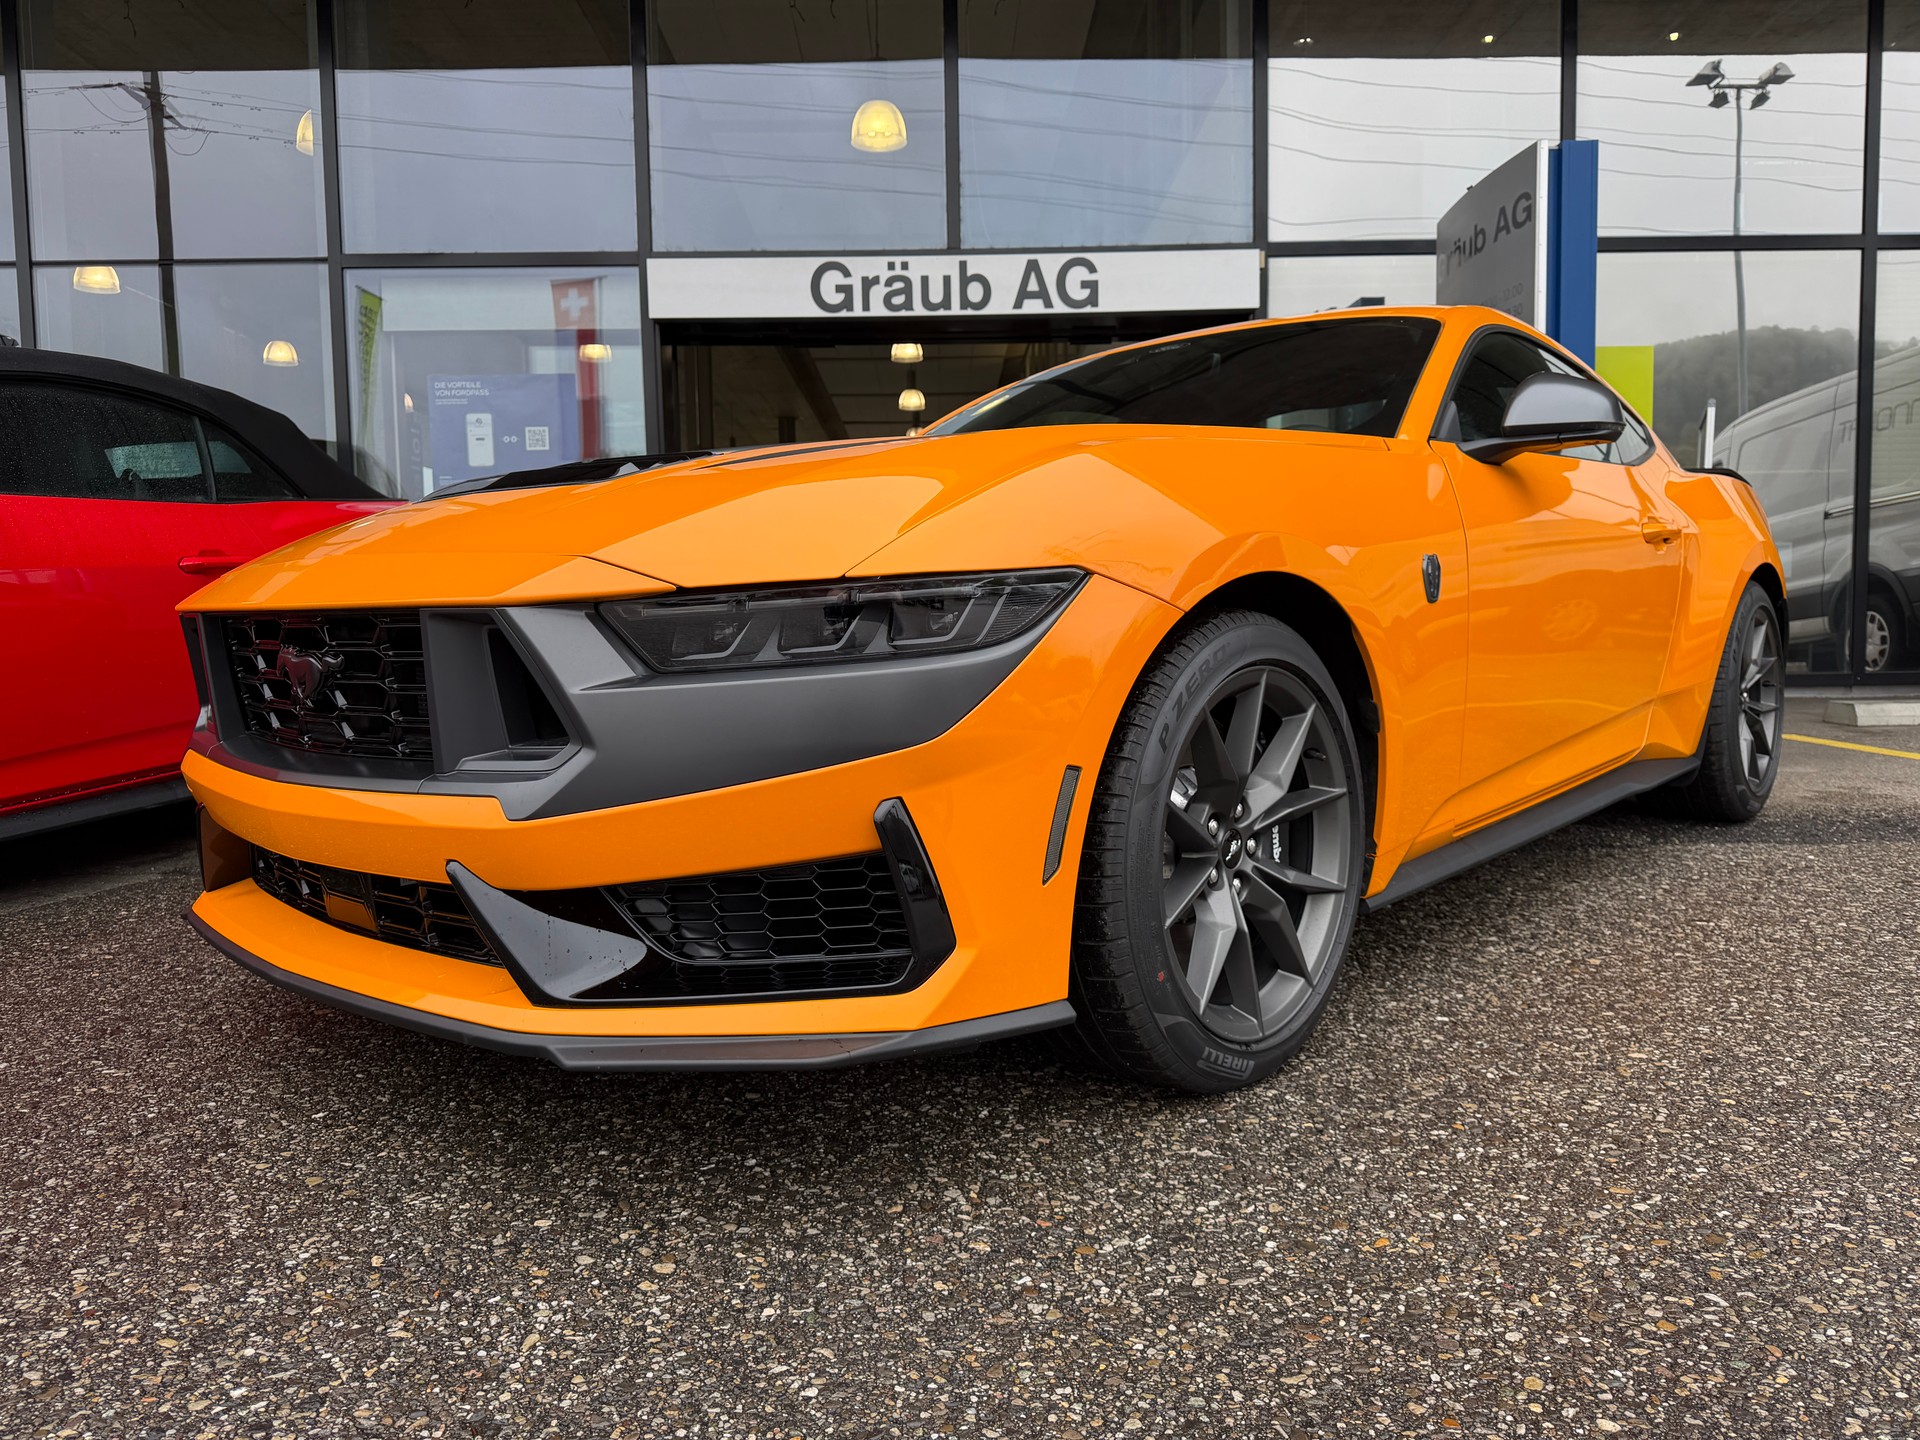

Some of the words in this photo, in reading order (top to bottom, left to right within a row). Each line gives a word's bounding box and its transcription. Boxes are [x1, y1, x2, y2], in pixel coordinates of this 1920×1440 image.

[1493, 191, 1532, 243] AG
[810, 260, 992, 313] Gräub
[1012, 257, 1099, 309] AG
[433, 389, 451, 397] VON
[434, 381, 446, 389] DIE
[447, 380, 481, 389] VORTEILE
[1158, 722, 1170, 754] P
[1172, 642, 1227, 722] ZERO
[1197, 1046, 1256, 1080] PIRELLI
